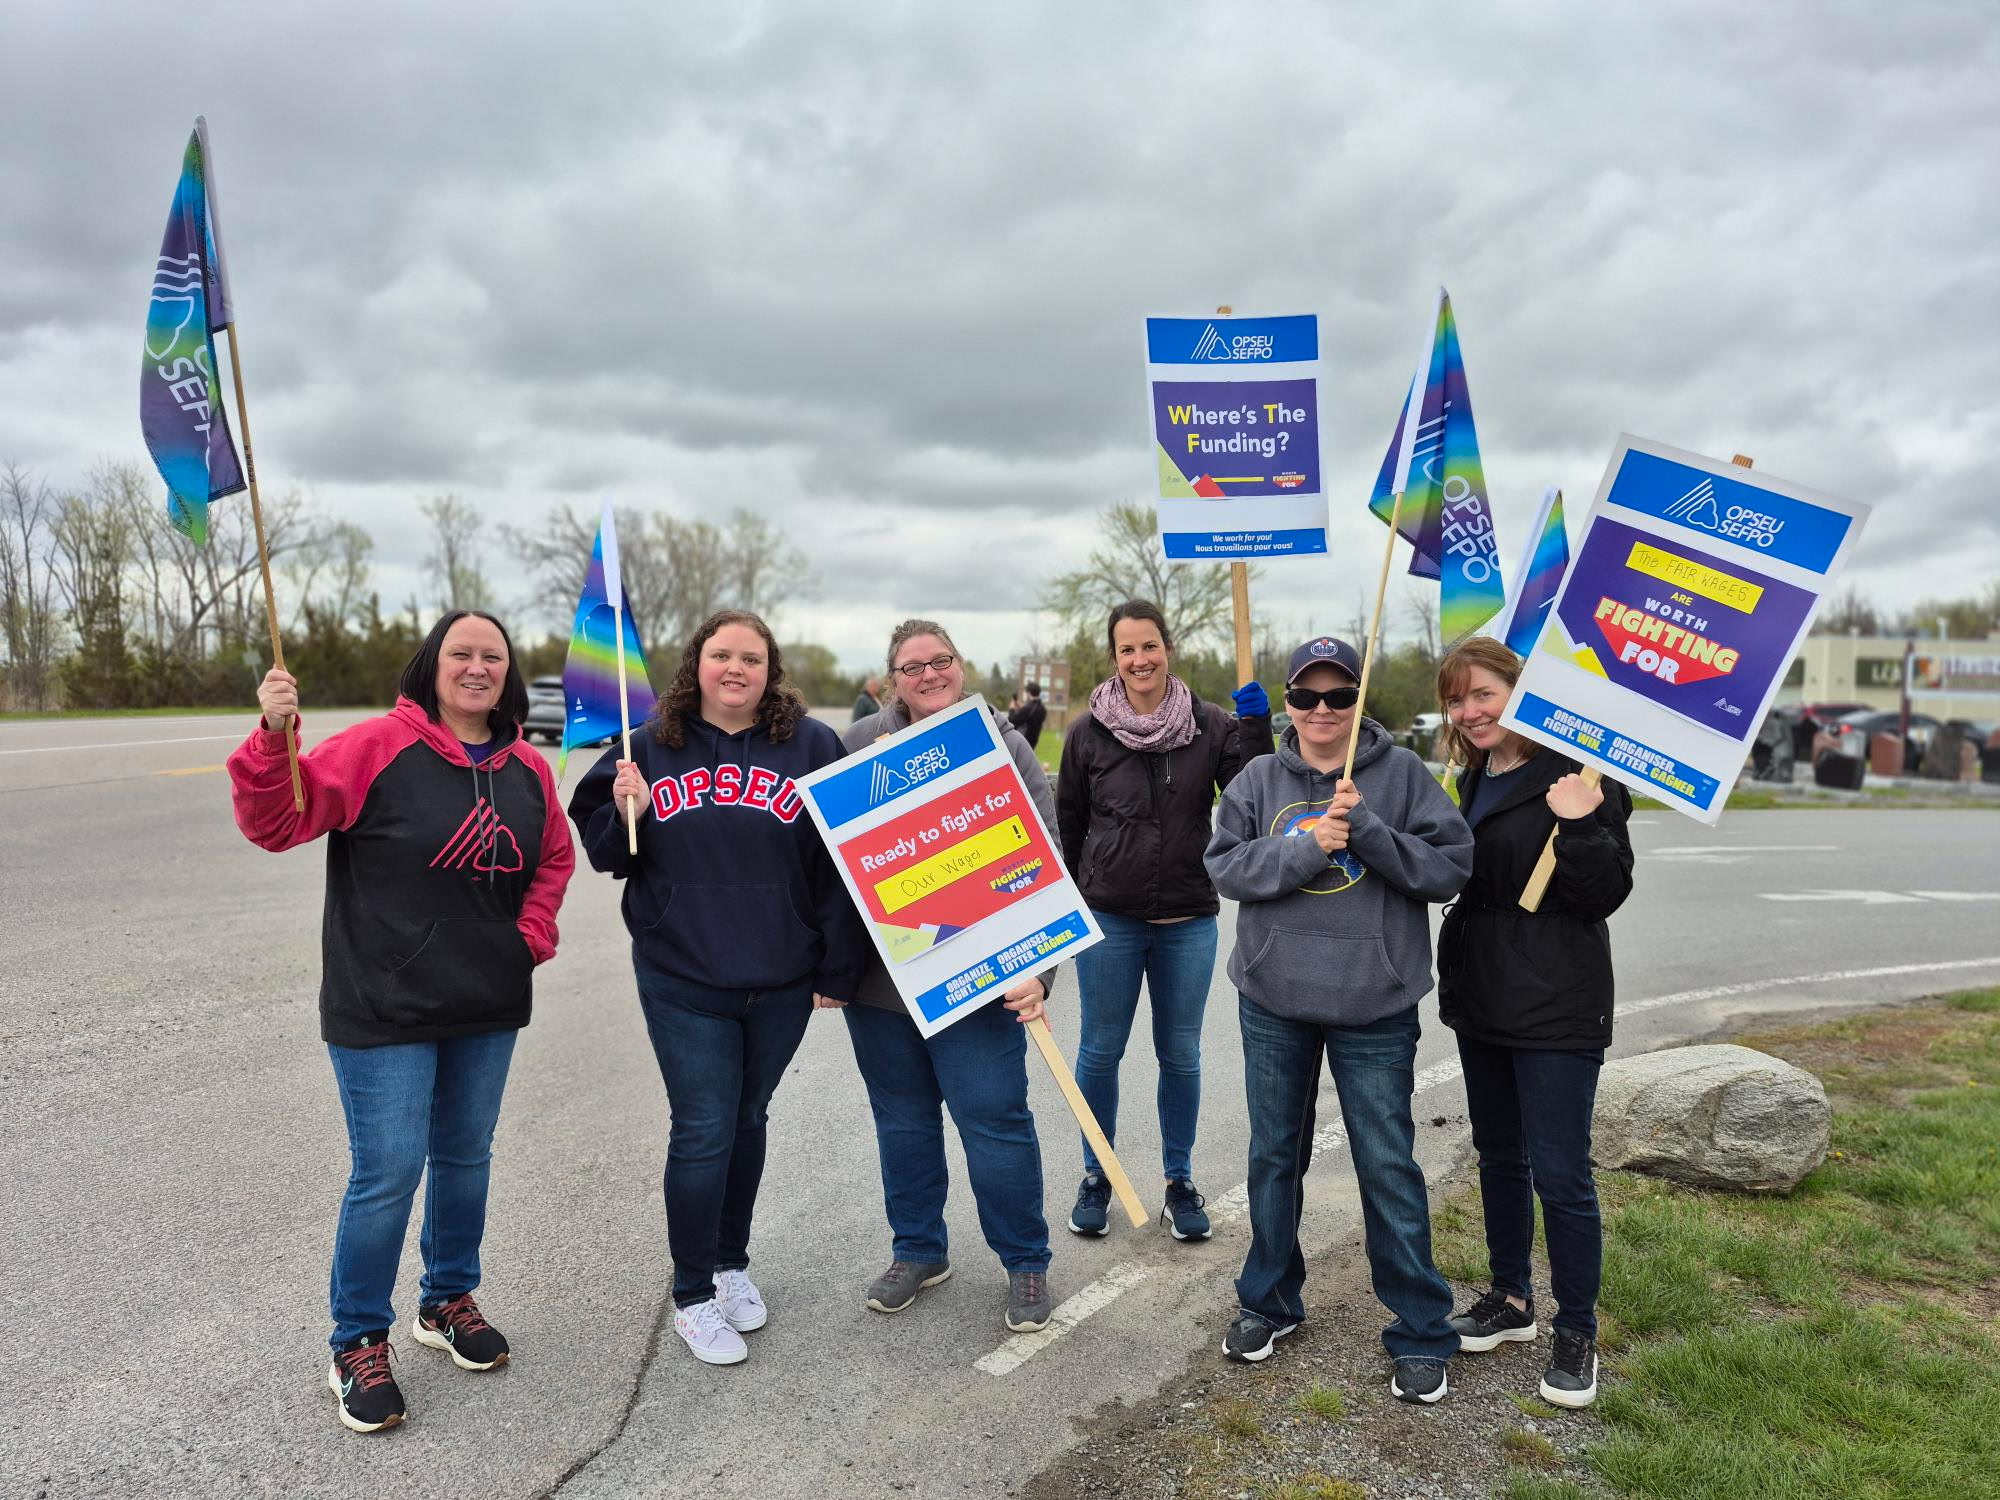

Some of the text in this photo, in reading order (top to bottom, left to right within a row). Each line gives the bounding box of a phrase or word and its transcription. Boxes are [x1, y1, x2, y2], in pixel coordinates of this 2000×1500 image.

[1232, 335, 1273, 347] OPSEU
[1232, 347, 1272, 359] SEFPO
[1168, 403, 1306, 425] Where's The
[1187, 431, 1290, 458] Funding?
[1717, 519, 1774, 547] SEFPO
[1726, 505, 1785, 534] OPSEU
[1195, 542, 1293, 552] Nous travaillons pour vous!
[1225, 534, 1243, 542] work
[1244, 533, 1255, 543] for
[1256, 533, 1273, 543] you!
[1636, 550, 1749, 602] The FAIR WAGES
[1644, 597, 1708, 632] WORTH
[1670, 591, 1694, 606] ARE
[1595, 597, 1740, 673] FIGHTING
[1620, 640, 1680, 684] FOR
[1543, 716, 1601, 752] FIGHT. WIN.
[1553, 709, 1606, 742] ORGANIZE.
[904, 743, 946, 772] OPSEU
[909, 756, 950, 784] SEFPO
[1612, 736, 1675, 775] ORGANISER.
[1607, 746, 1649, 775] LUTTER.
[1650, 767, 1696, 799] GAGNER.
[651, 764, 805, 823] OPSEU
[860, 790, 1012, 873] Ready to fight for
[1012, 824, 1022, 839] !
[900, 872, 936, 897] Our
[990, 857, 1043, 890] FIGHTING
[1009, 876, 1033, 893] FOR
[996, 931, 1052, 965] ORGANISER.
[1001, 929, 1077, 975] LUTTER. GAGNER.
[945, 961, 995, 993] ORGANIZE.
[945, 971, 999, 1006] FIGHT. WIN.
